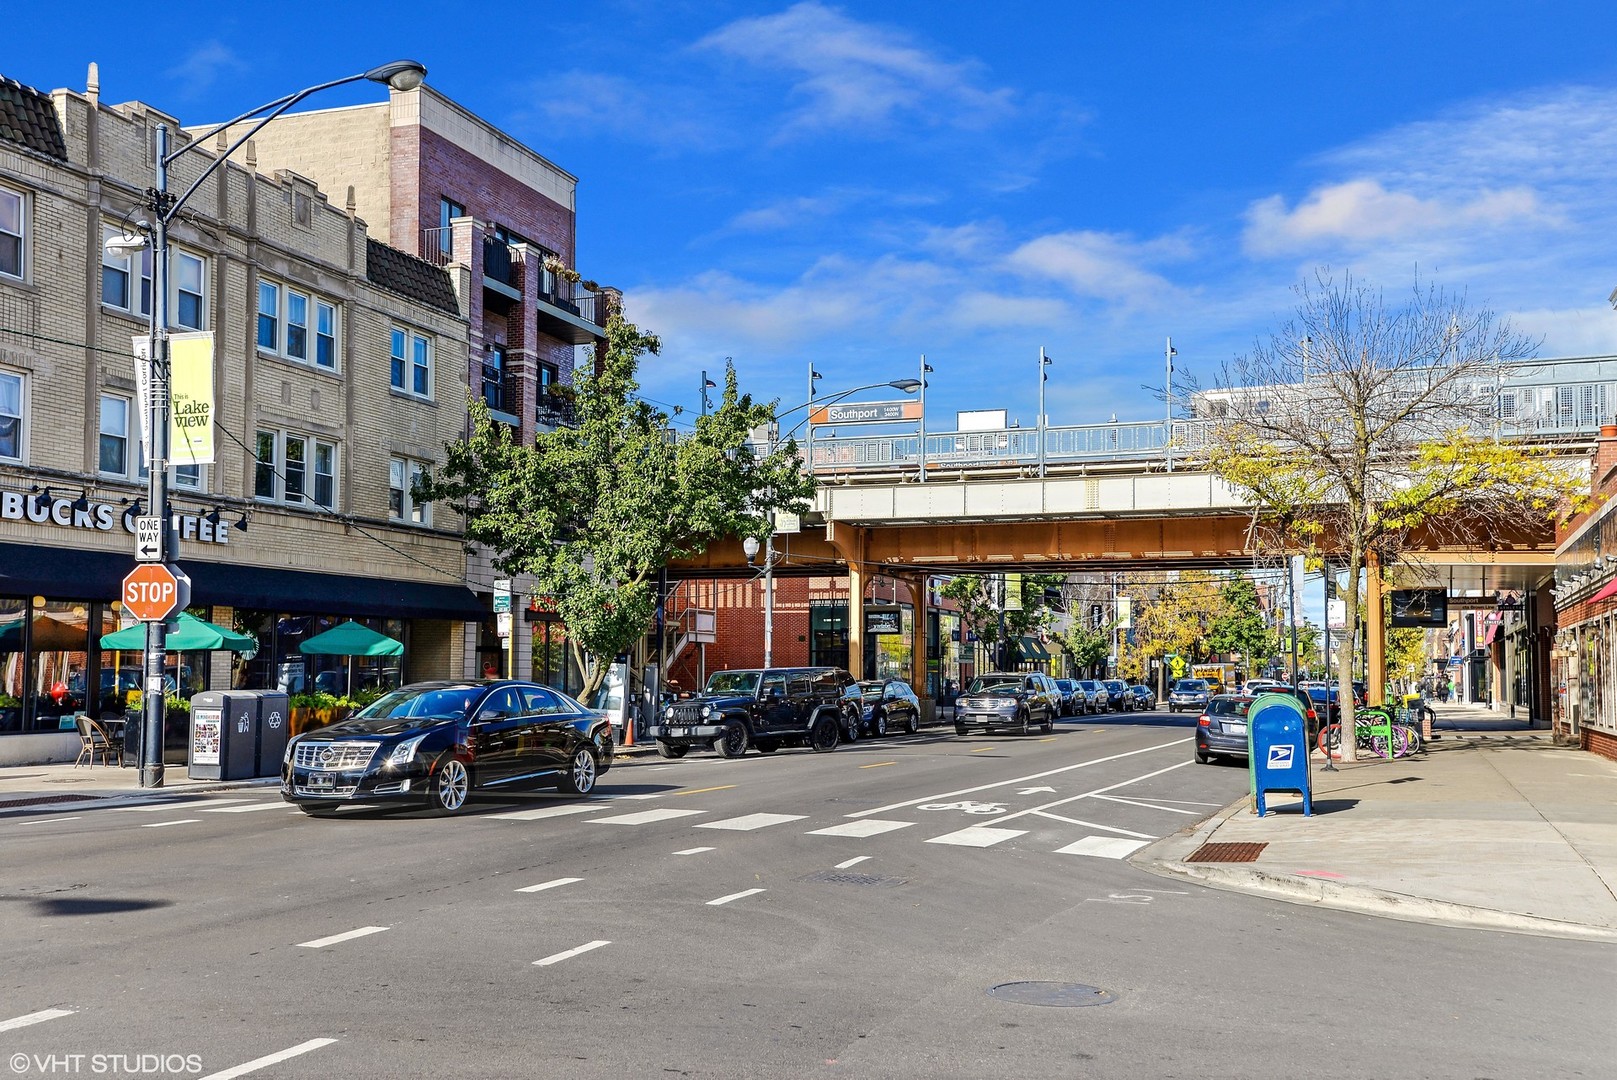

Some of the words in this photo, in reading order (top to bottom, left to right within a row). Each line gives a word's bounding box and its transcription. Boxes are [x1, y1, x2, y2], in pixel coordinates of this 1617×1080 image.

[174, 392, 184, 400] This
[185, 392, 189, 400] is
[174, 400, 210, 415] Lake
[831, 409, 878, 420] Southport
[174, 415, 210, 428] view
[2, 491, 114, 531] BUCKS
[139, 519, 159, 531] ONE
[139, 532, 160, 543] WAY
[127, 581, 174, 603] STOP
